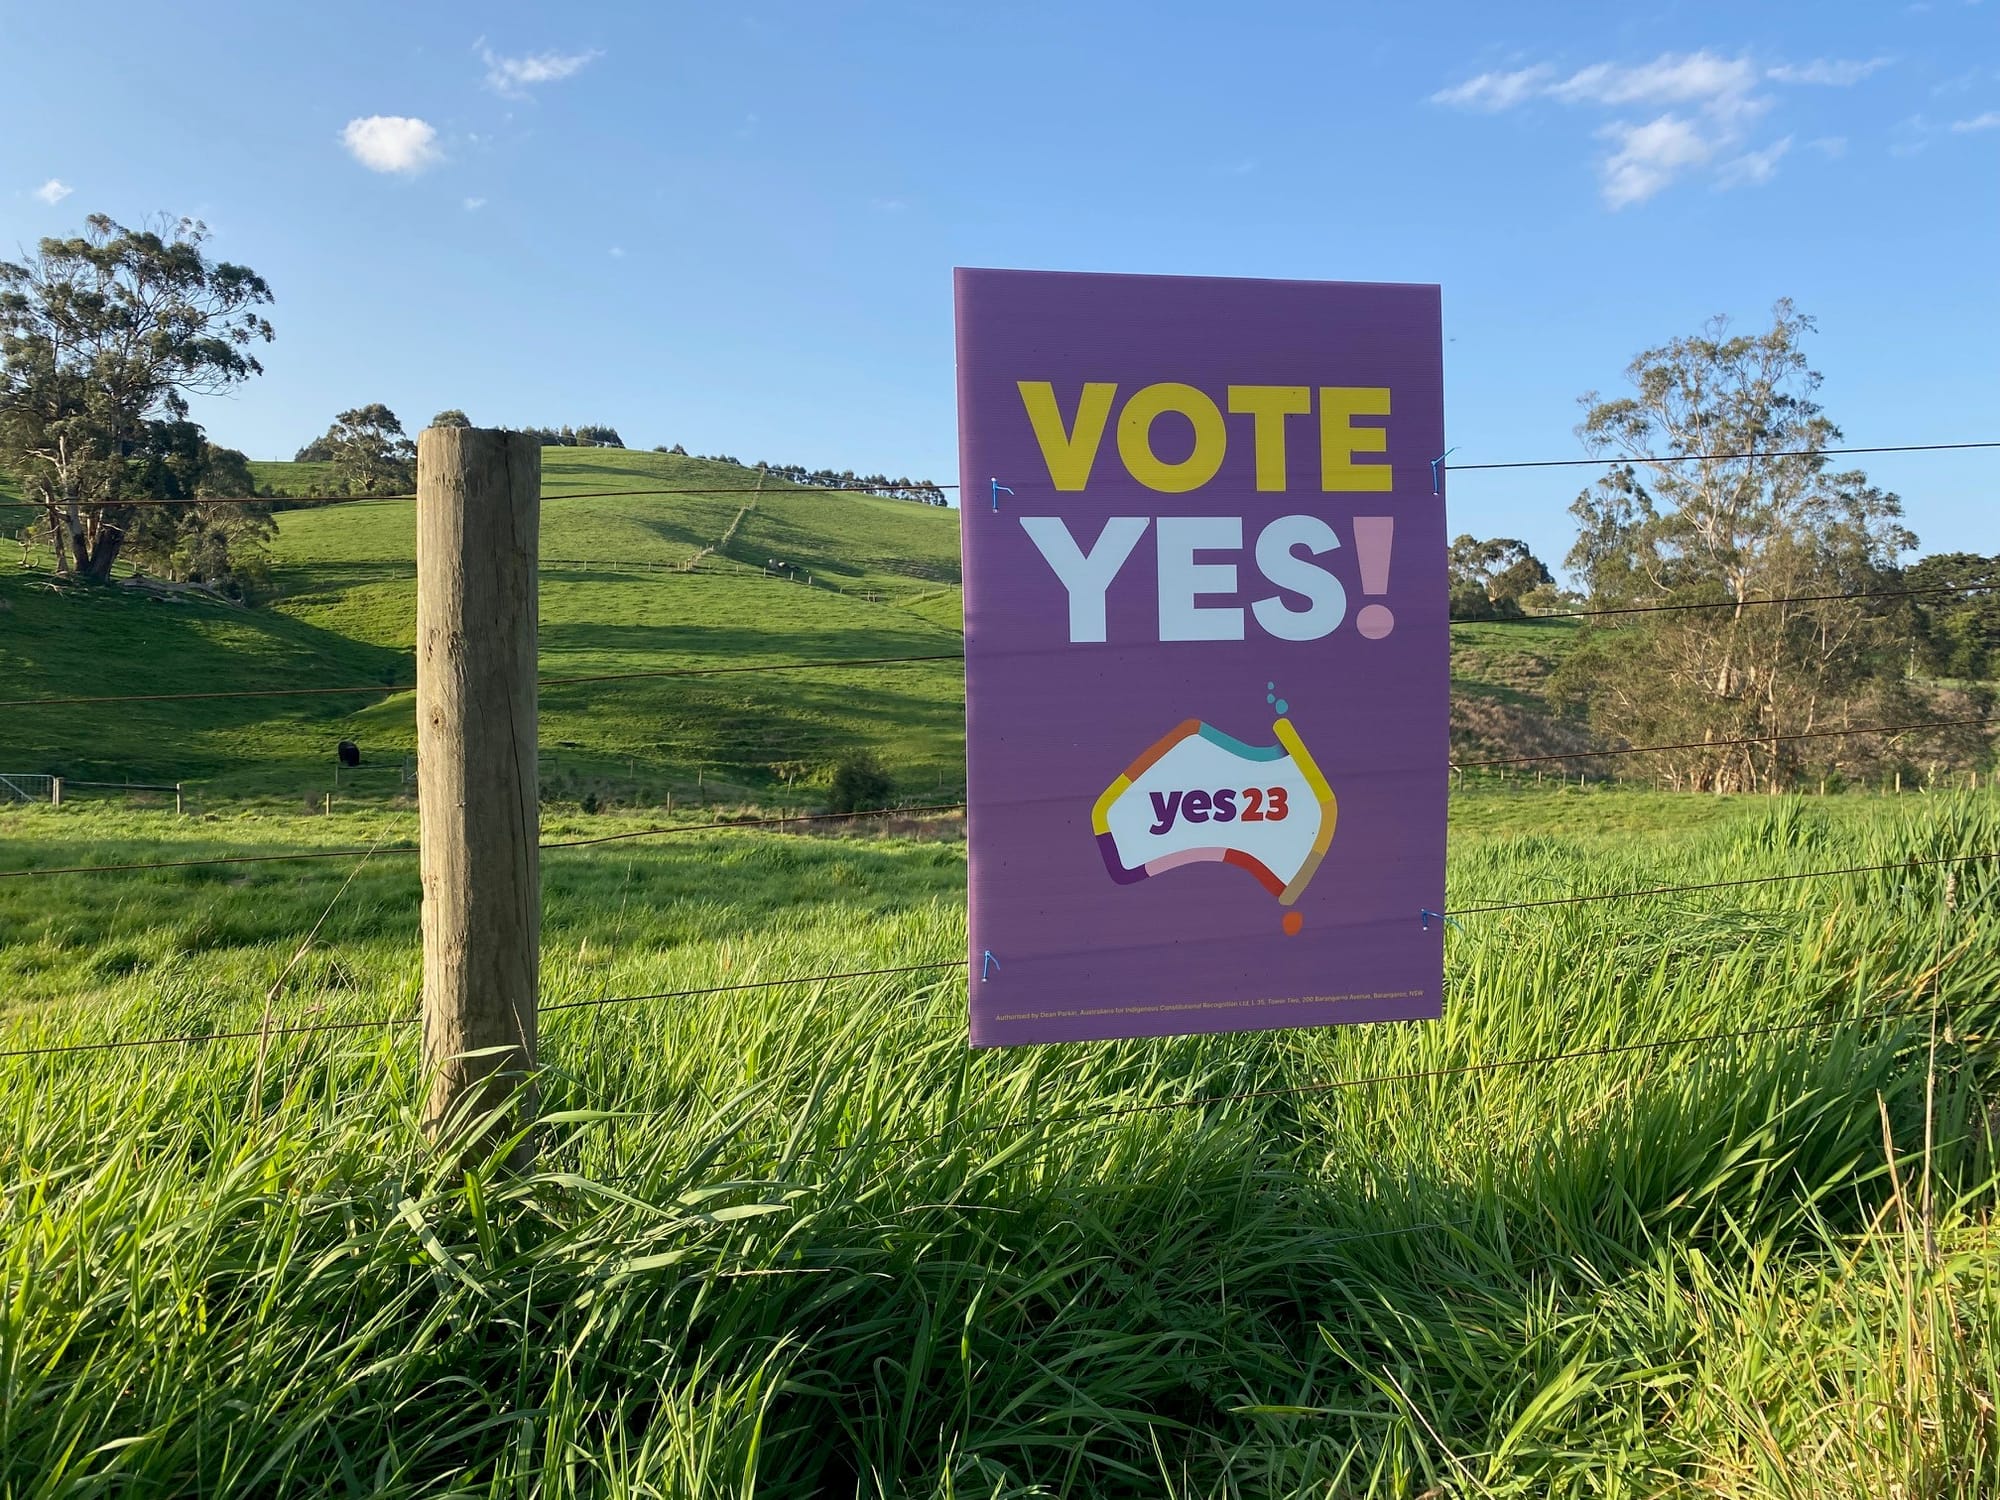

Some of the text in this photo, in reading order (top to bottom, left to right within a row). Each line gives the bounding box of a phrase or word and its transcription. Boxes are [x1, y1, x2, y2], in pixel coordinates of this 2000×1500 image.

[1016, 381, 1393, 493] VOTE
[1019, 514, 1394, 643] YES!
[1149, 787, 1289, 836] yes23
